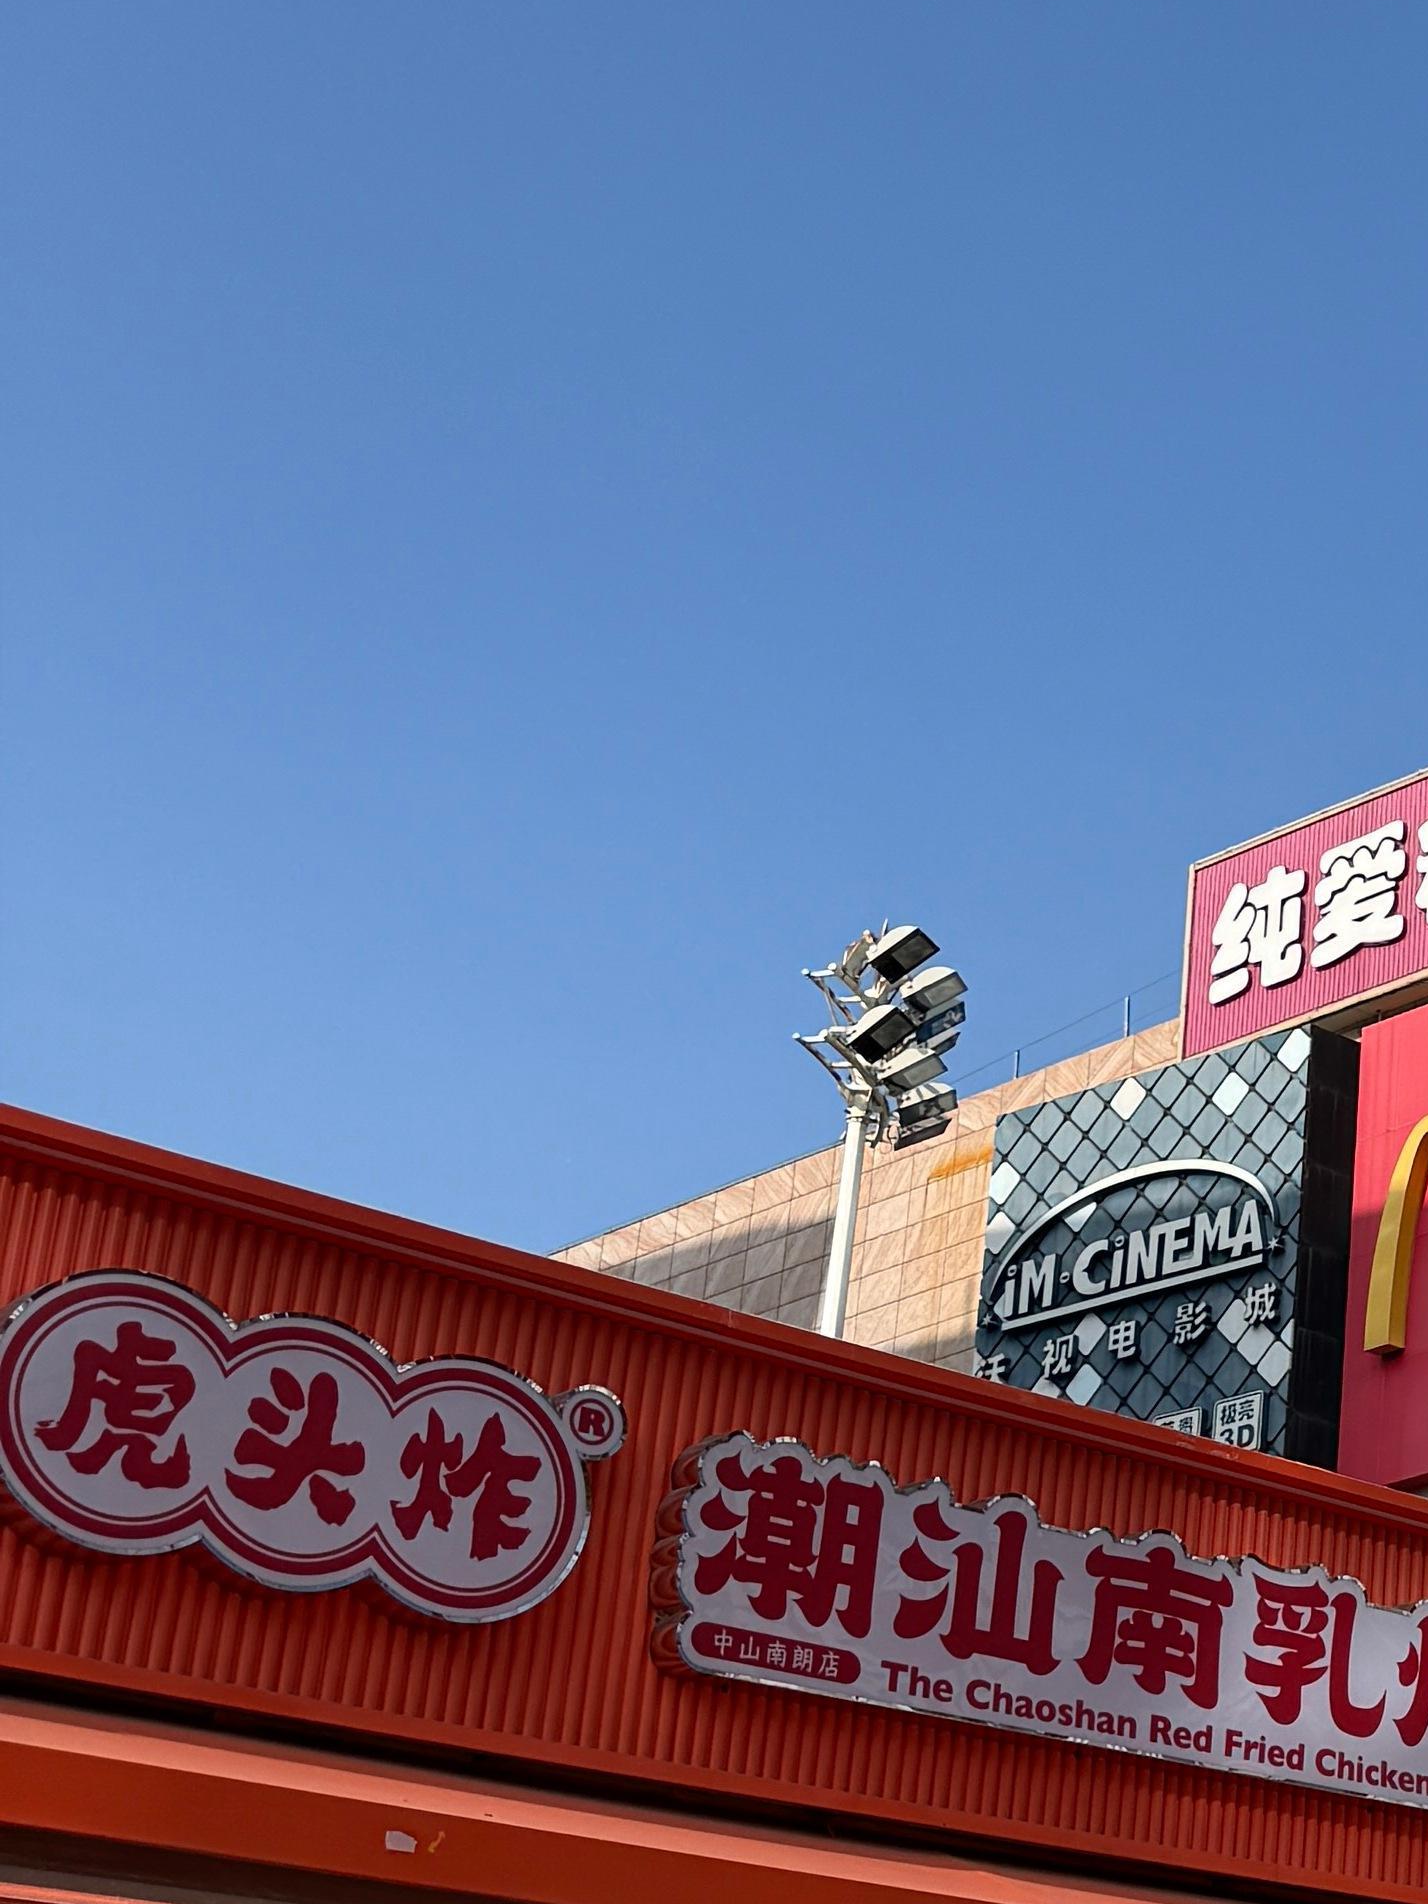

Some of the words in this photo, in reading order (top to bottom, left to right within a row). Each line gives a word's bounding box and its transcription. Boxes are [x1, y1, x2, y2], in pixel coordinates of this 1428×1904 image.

[34, 1320, 542, 1561] 虎头炸
[1219, 1424, 1255, 1448] 3D
[713, 1628, 842, 1678] 中山南朗店
[881, 1659, 953, 1702] The
[965, 1679, 1137, 1740] Chaoshan
[1149, 1714, 1213, 1754] Red
[1223, 1728, 1305, 1772] Fried
